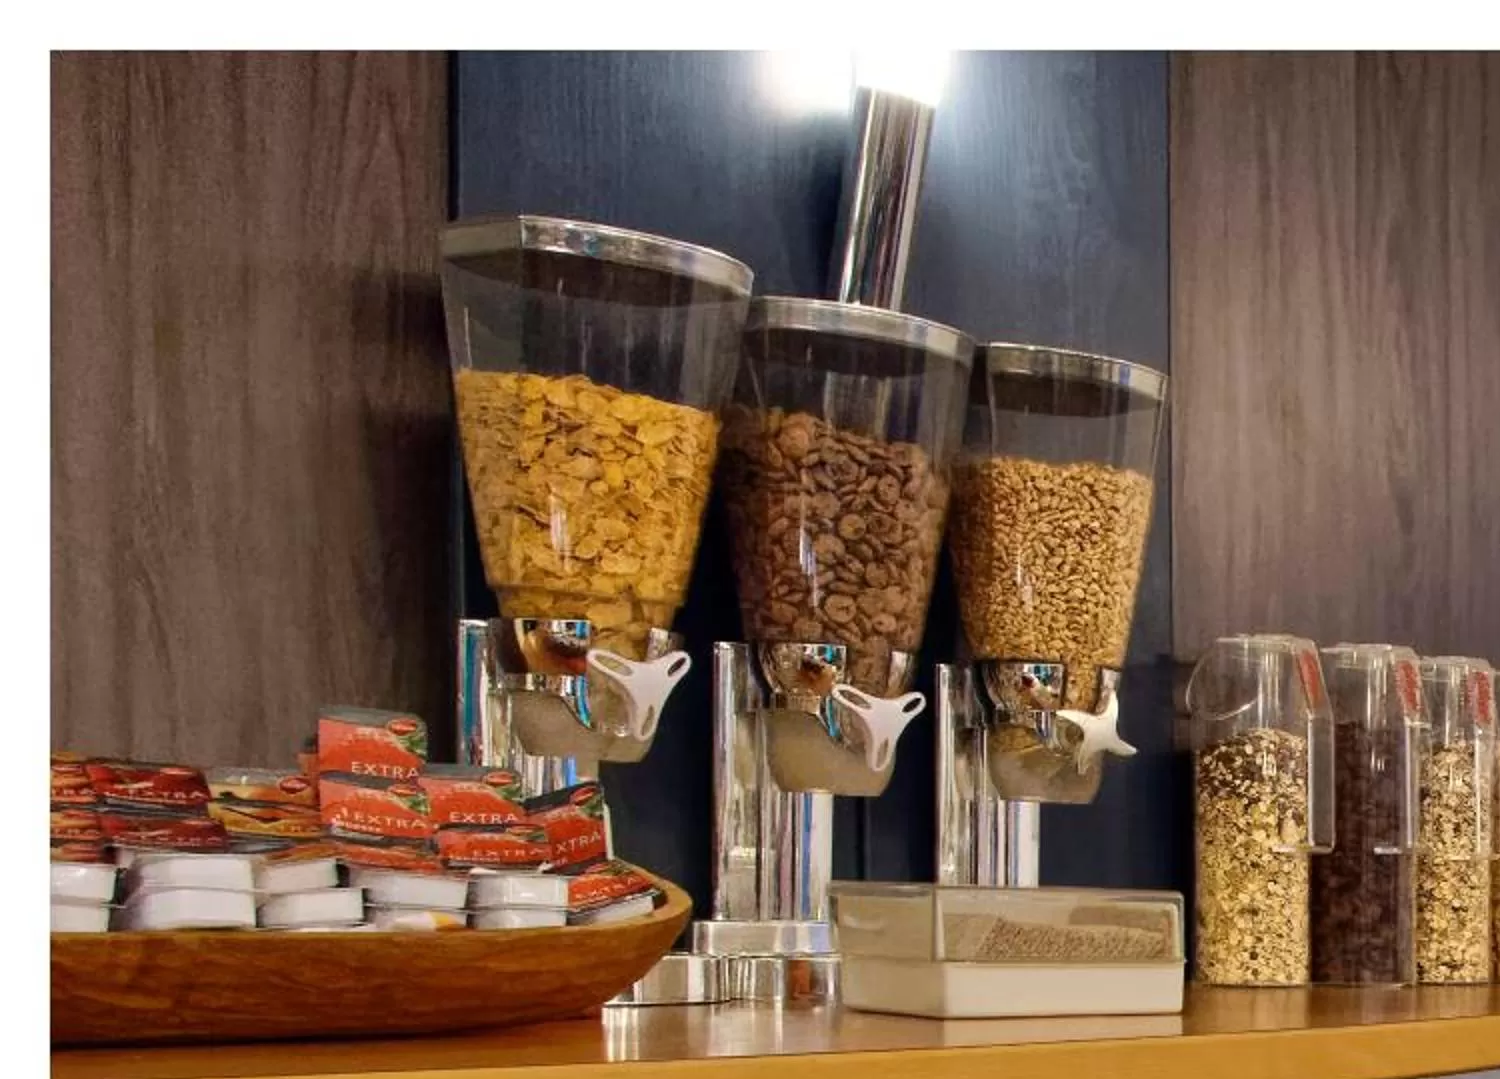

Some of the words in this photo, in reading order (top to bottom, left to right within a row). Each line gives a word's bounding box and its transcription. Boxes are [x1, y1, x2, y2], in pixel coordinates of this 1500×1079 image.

[351, 761, 420, 779] EXTRA
[354, 811, 428, 829] EXTRA
[449, 812, 519, 824] EXTRA
[556, 829, 601, 854] XTRA
